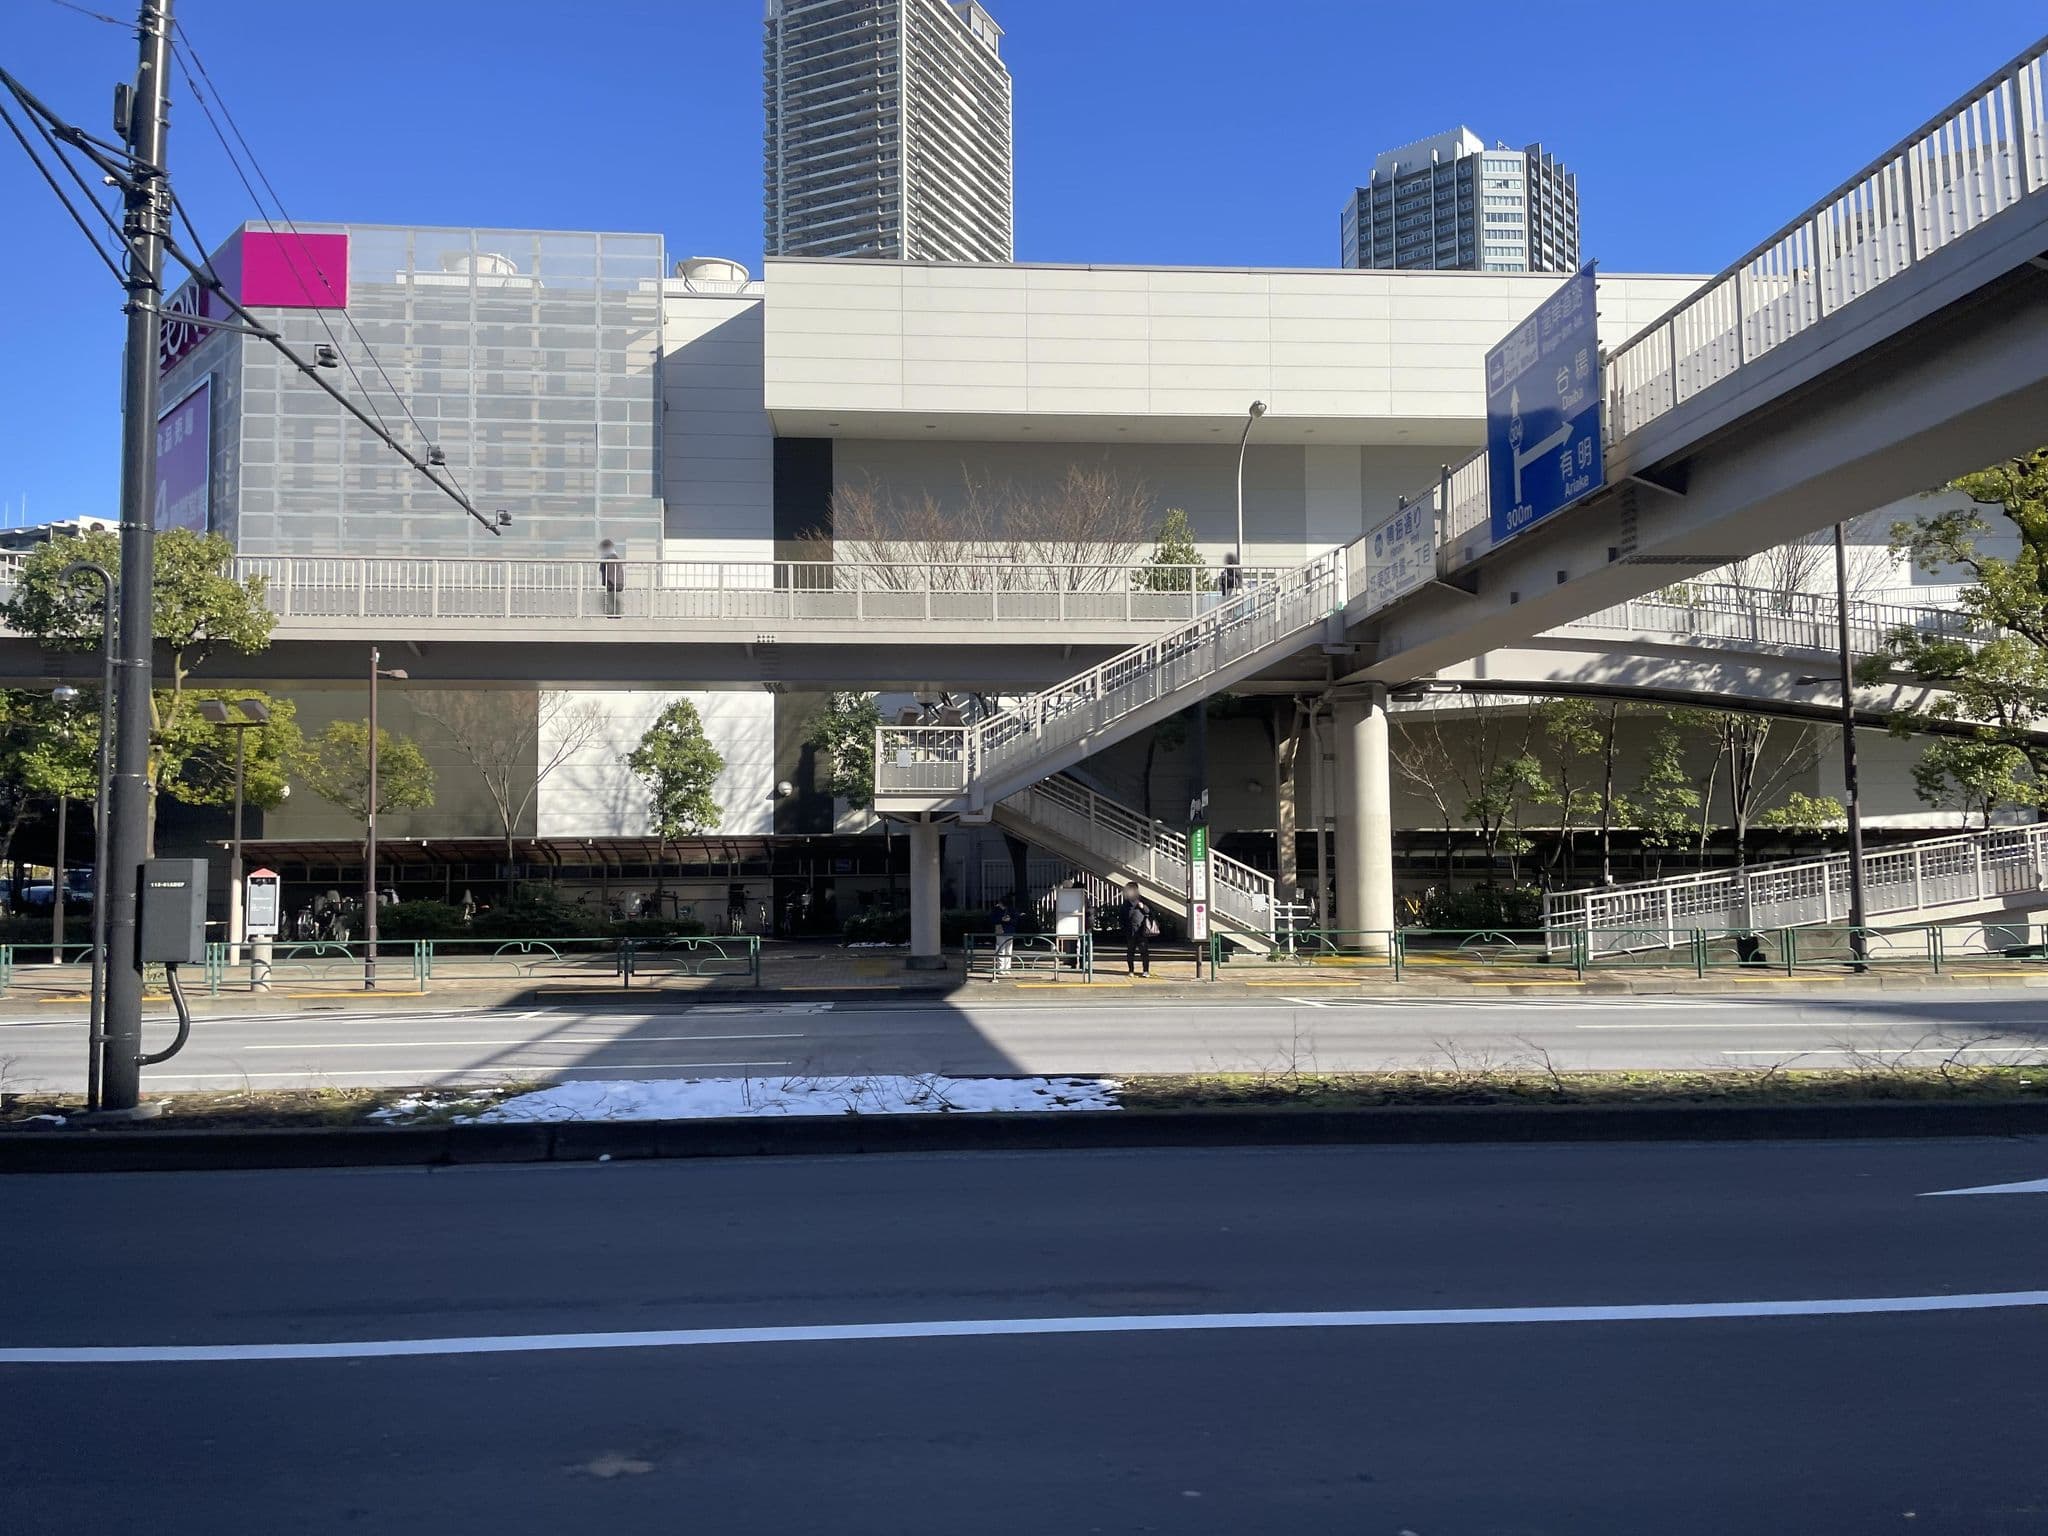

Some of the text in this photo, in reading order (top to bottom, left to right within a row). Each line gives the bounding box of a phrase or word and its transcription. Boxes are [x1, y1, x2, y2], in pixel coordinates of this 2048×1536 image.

[1560, 436, 1592, 480] 有明
[1565, 474, 1590, 498] Ariake
[1506, 504, 1533, 531] 300m
